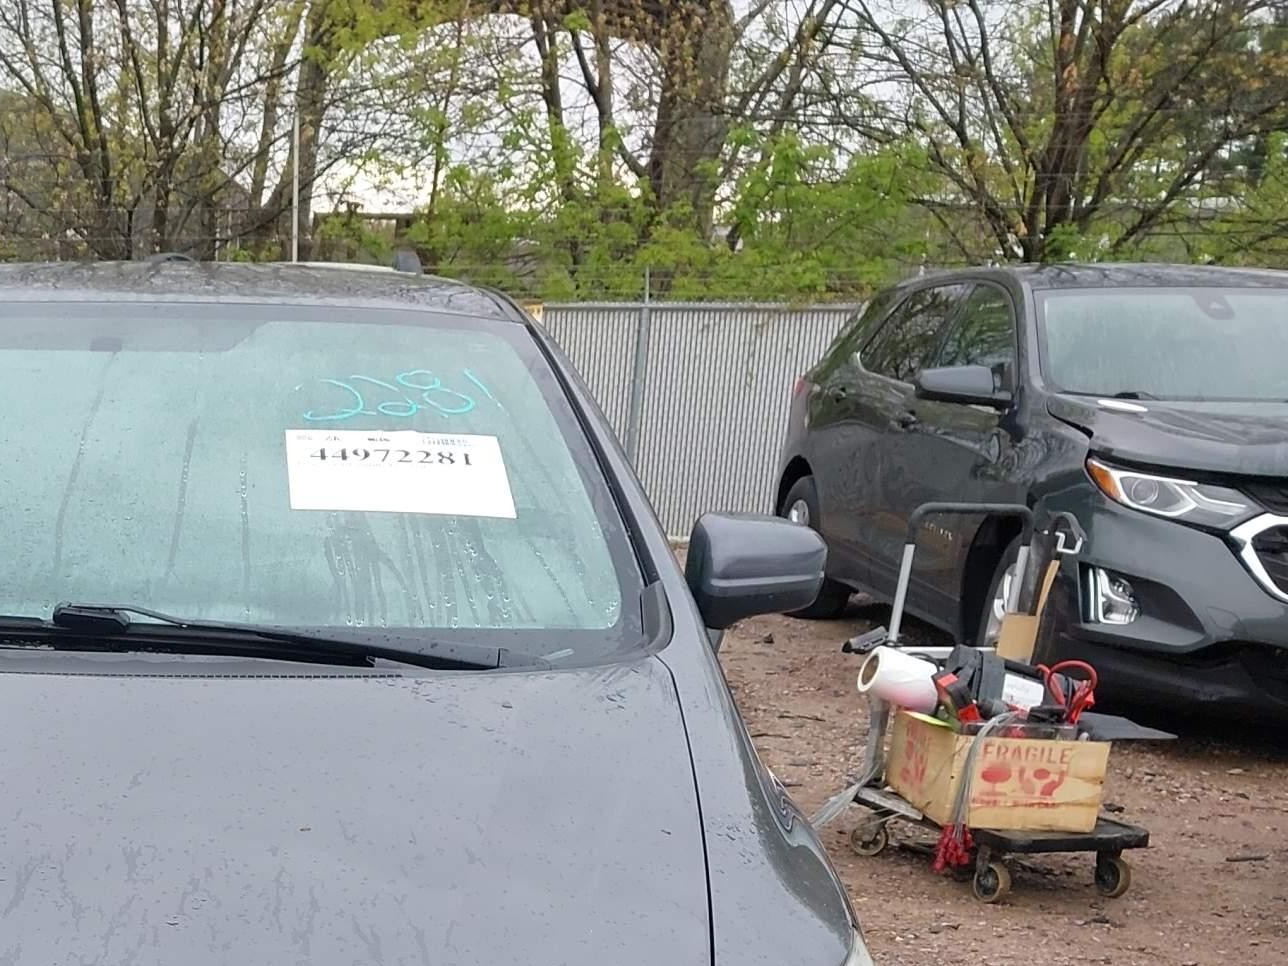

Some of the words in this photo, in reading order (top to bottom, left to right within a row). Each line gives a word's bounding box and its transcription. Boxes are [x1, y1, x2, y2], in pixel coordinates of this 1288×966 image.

[303, 368, 509, 421] 2281
[309, 447, 473, 466] 44972281
[982, 742, 1073, 765] FRAGILE
